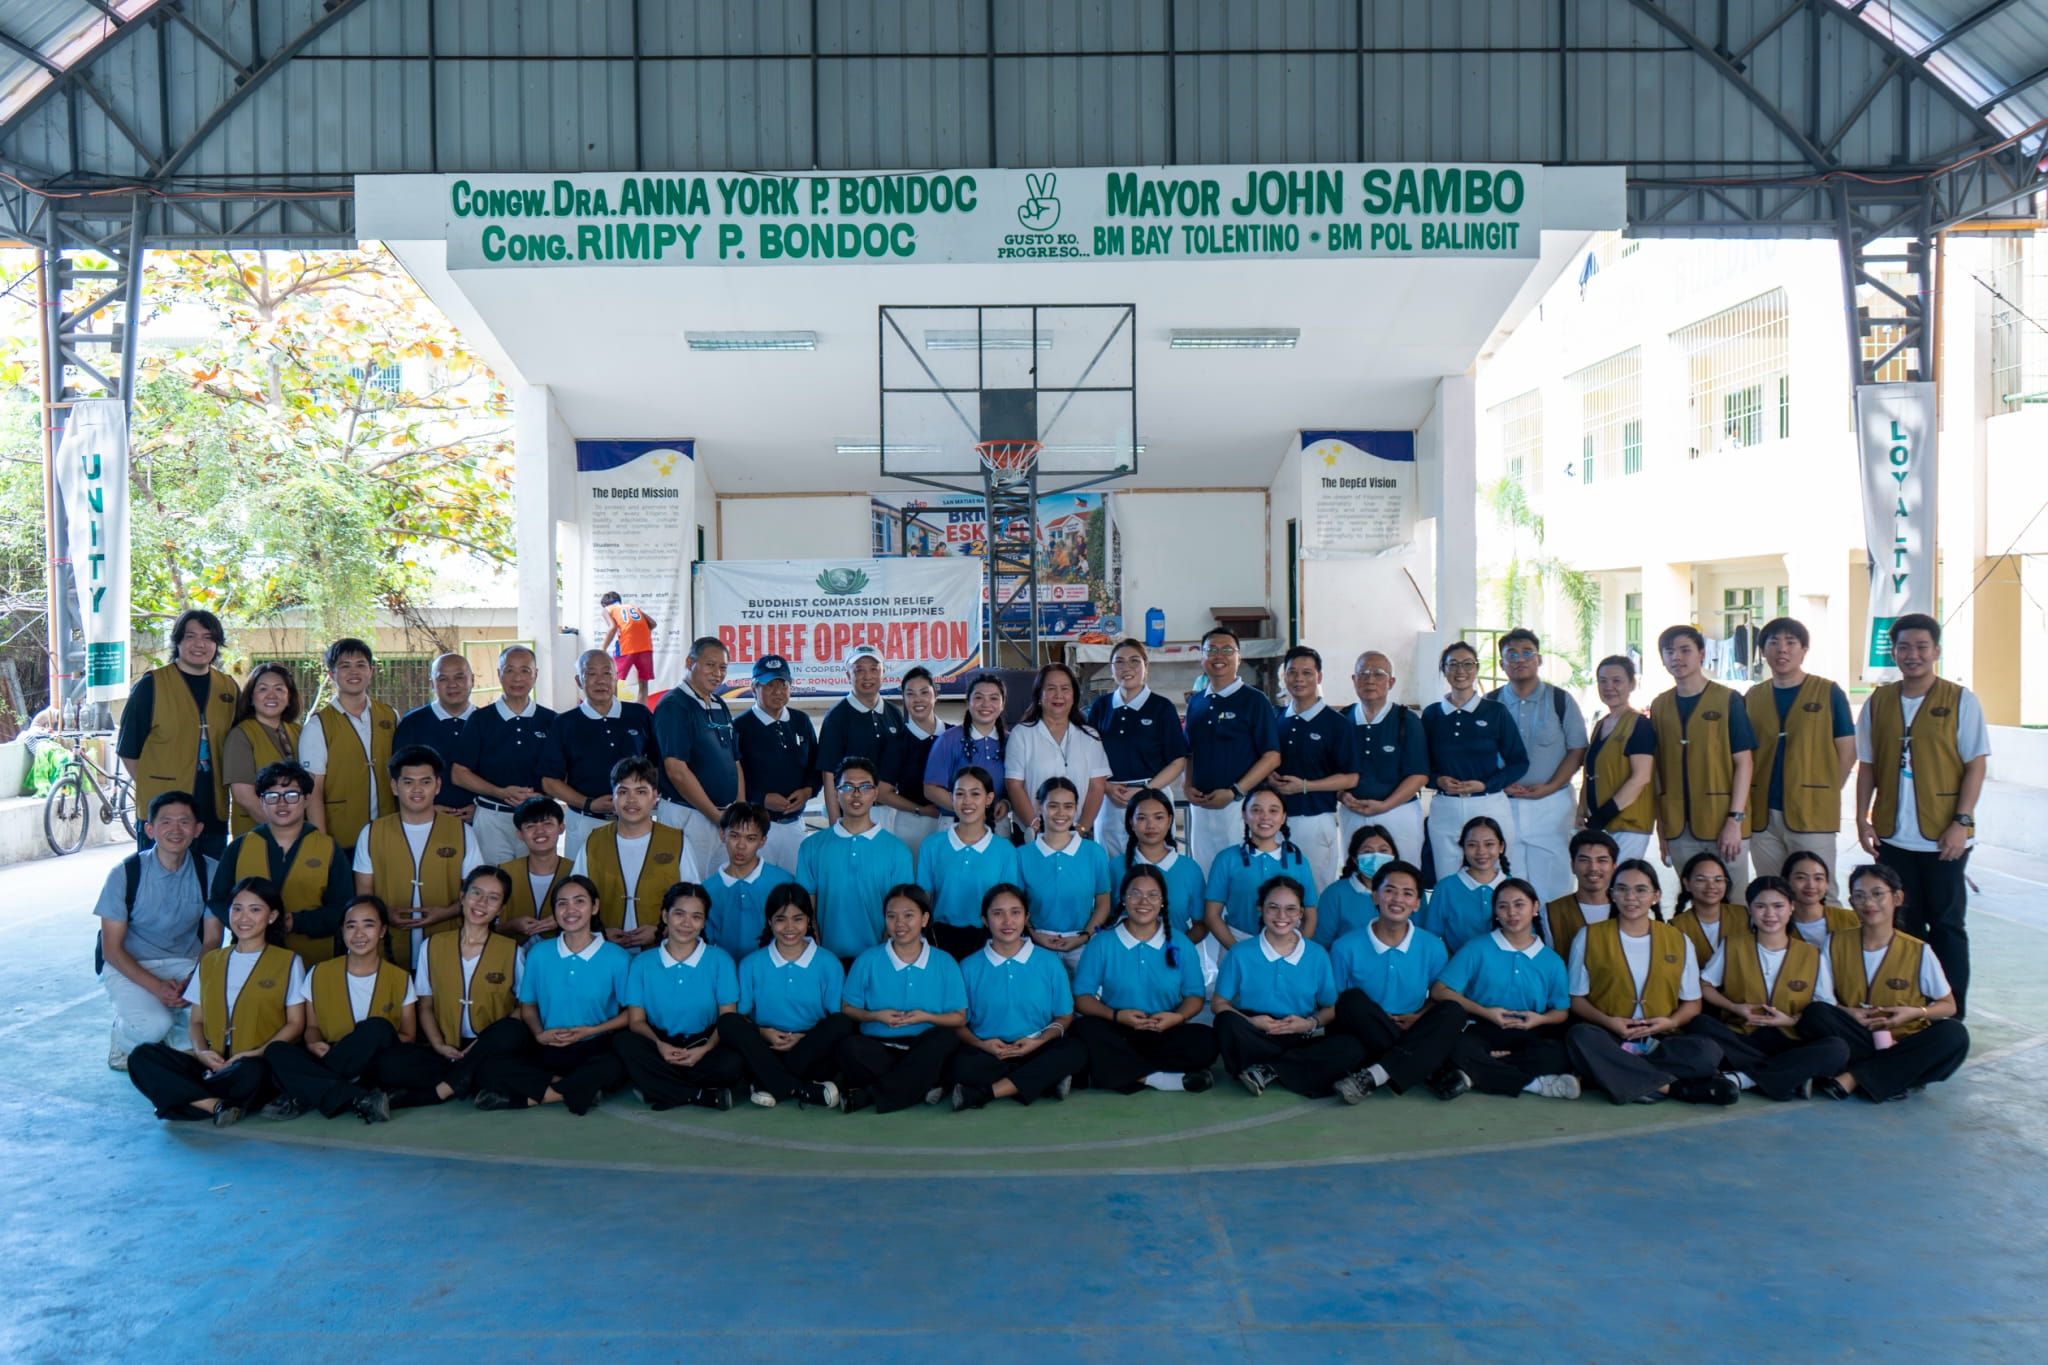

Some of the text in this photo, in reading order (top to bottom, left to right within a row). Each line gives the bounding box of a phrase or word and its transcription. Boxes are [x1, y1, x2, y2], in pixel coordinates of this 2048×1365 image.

[619, 178, 711, 216] ANNA
[717, 177, 800, 216] YORK
[811, 177, 830, 216] P.
[839, 175, 978, 215] BONDOC
[1107, 168, 1524, 217] MAYOR JOHN SAMBO
[481, 222, 916, 262] CONG. RIMPY P. BONDOC
[1004, 233, 1080, 245] GUSTO KO.
[1093, 221, 1520, 256] BM BAY TOLENTINO BM POL BALINGIT
[997, 246, 1091, 259] PROGRESO...
[1321, 477, 1397, 489] The DepEd Vision
[592, 487, 679, 500] The DepEd Mission
[1889, 420, 1909, 594] LOYALTY
[81, 453, 107, 613] UNITY
[748, 596, 934, 608] BUDDHIST COMPASSION RELIEF
[621, 608, 642, 622] 15
[741, 607, 945, 619] TZU CHI FOUNDATION PHILIPPINES
[719, 621, 968, 662] RELIEF OPERATION
[805, 665, 847, 673] COOPERA
[808, 678, 848, 686] RONQUIL
